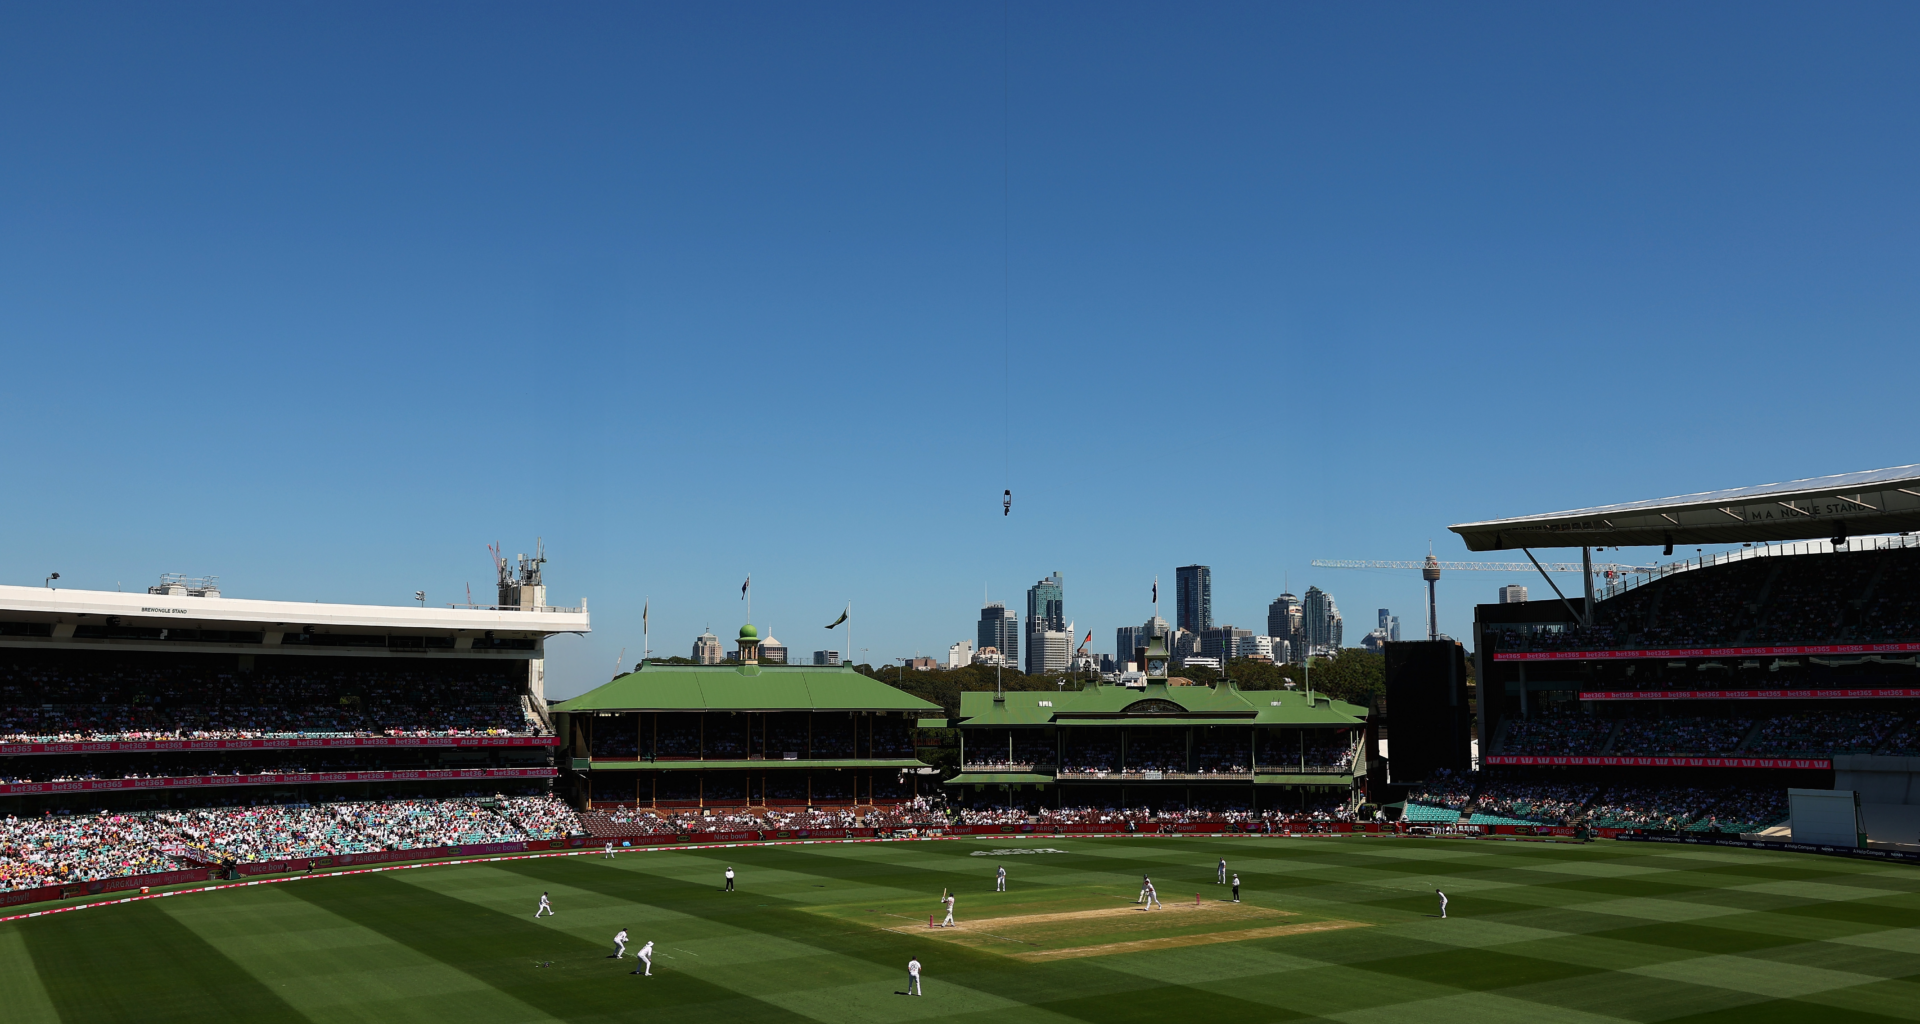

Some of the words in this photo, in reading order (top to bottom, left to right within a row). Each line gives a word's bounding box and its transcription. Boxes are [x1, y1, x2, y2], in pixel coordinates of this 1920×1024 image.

[1752, 511, 1762, 520] M
[1766, 510, 1773, 519] A
[1781, 504, 1820, 518] NOBLE
[1826, 502, 1866, 513] STAND
[356, 853, 389, 862] FÄRGKLAR
[106, 879, 142, 890] FÄRGKLAR
[7, 892, 29, 903] bowl!
